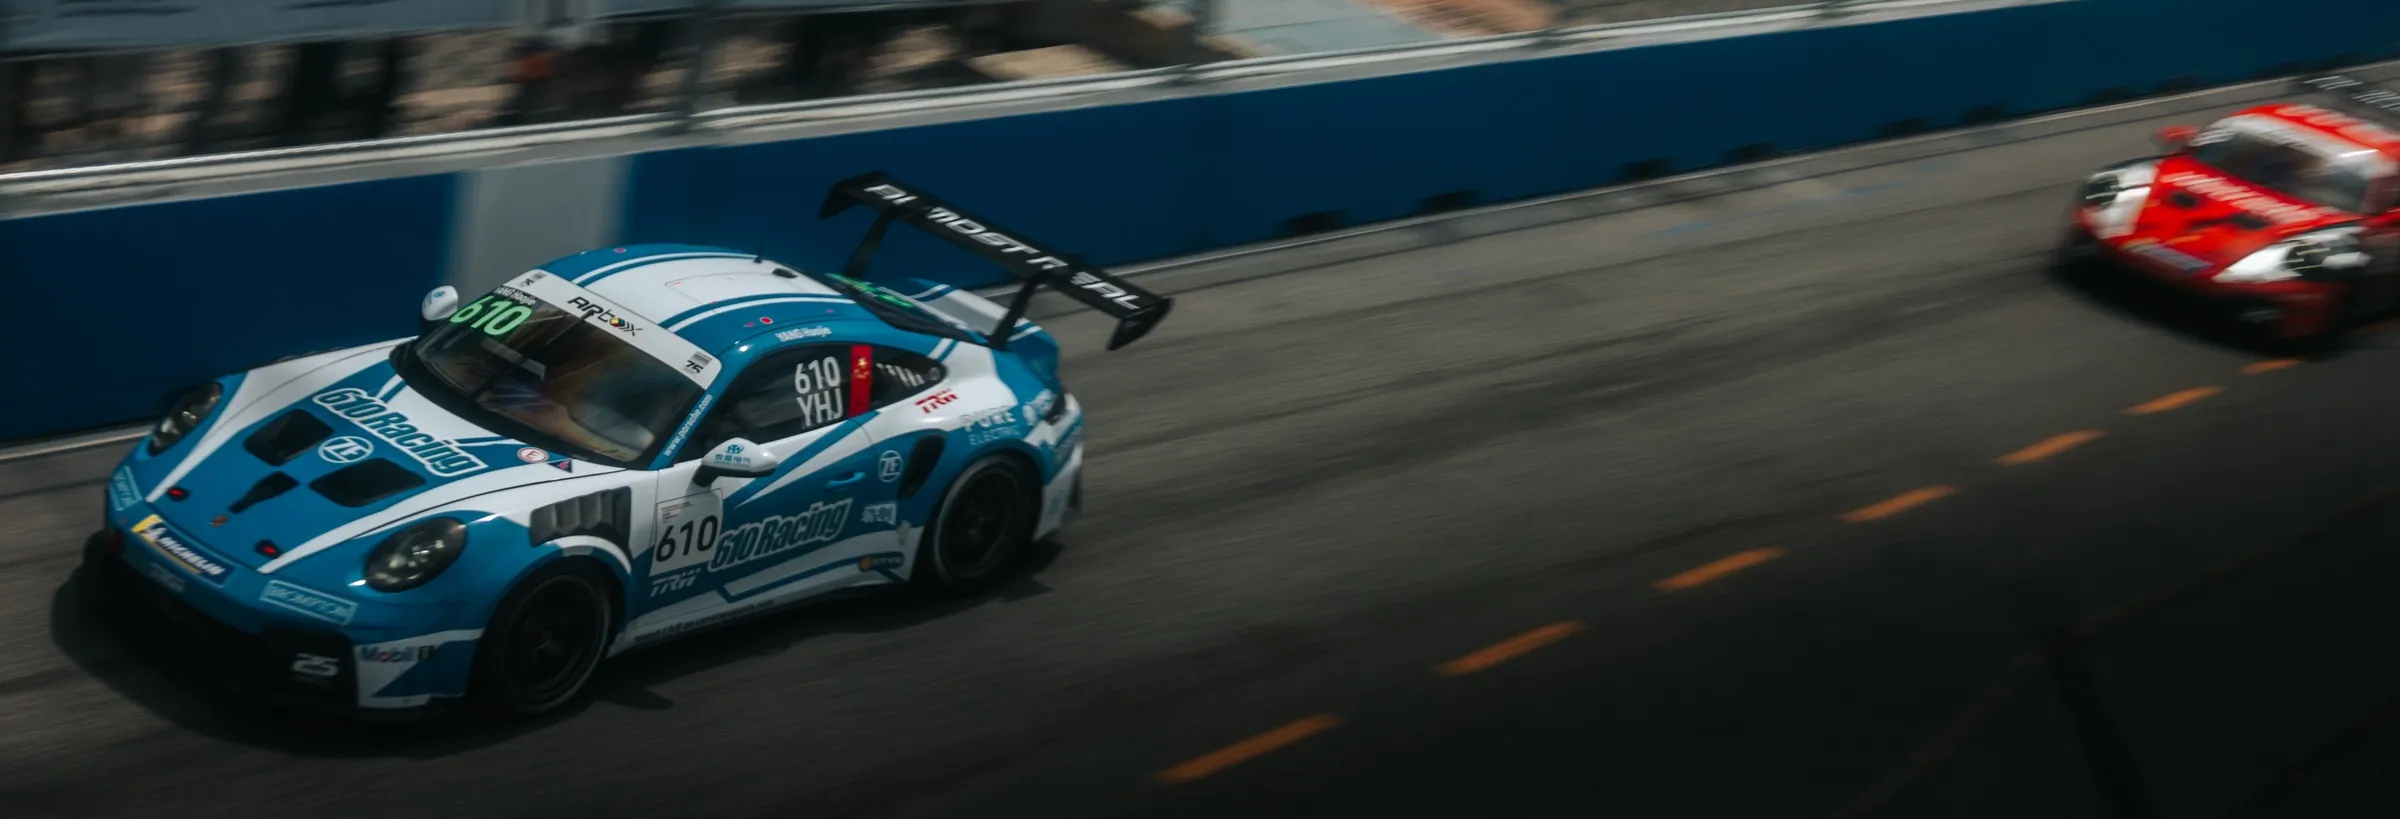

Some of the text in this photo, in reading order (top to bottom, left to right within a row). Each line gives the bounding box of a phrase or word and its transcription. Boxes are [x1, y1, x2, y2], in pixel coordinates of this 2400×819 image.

[450, 295, 532, 336] 610
[686, 360, 704, 373] 75
[794, 356, 841, 394] 610
[796, 388, 843, 427] YHJ
[915, 391, 959, 414] TRW
[663, 393, 713, 456] www.porsche.com
[321, 437, 371, 463] ZF
[880, 455, 901, 478] ZF
[655, 515, 718, 562] 610
[157, 537, 226, 575] MICHELIN
[650, 571, 698, 597] TRW
[291, 652, 340, 677] 25
[360, 646, 414, 663] Mobil
